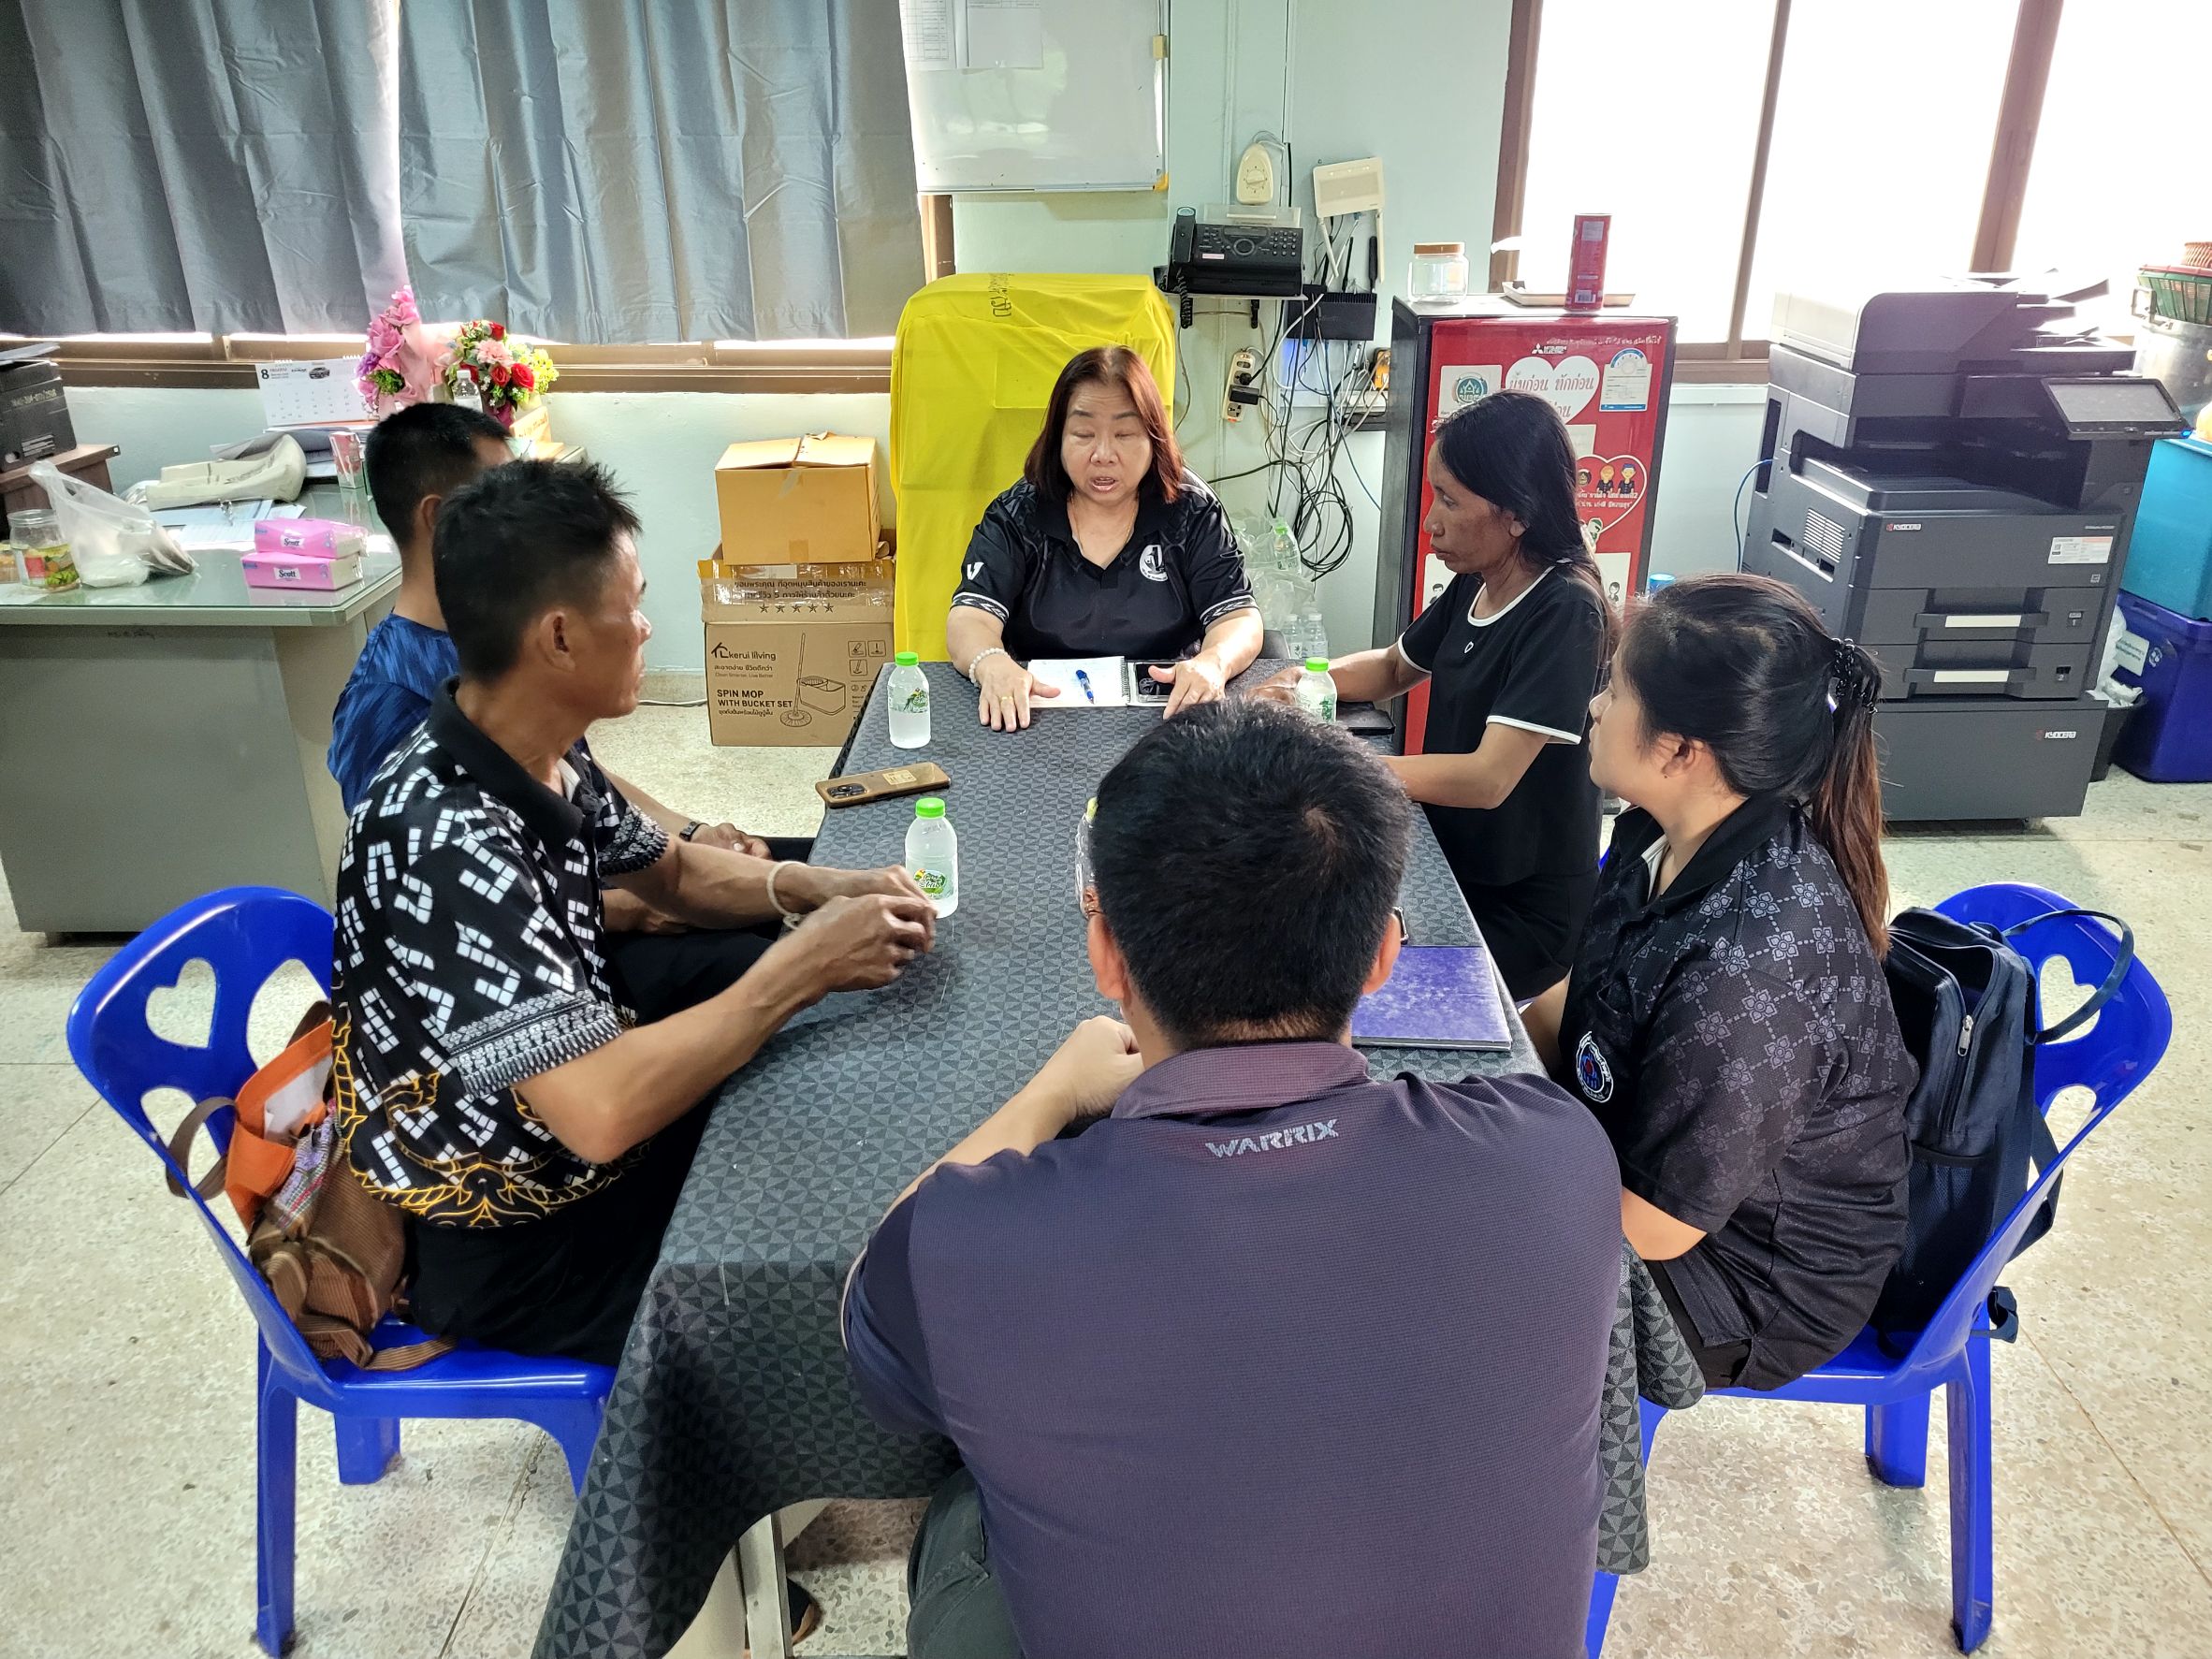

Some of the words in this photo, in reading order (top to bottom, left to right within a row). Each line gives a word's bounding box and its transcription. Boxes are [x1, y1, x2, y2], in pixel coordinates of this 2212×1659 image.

[261, 369, 269, 379] 8
[278, 569, 296, 577] Scott
[717, 689, 739, 697] SPIN
[742, 690, 764, 698] MOP
[1205, 1118, 1339, 1158] WARRIX
